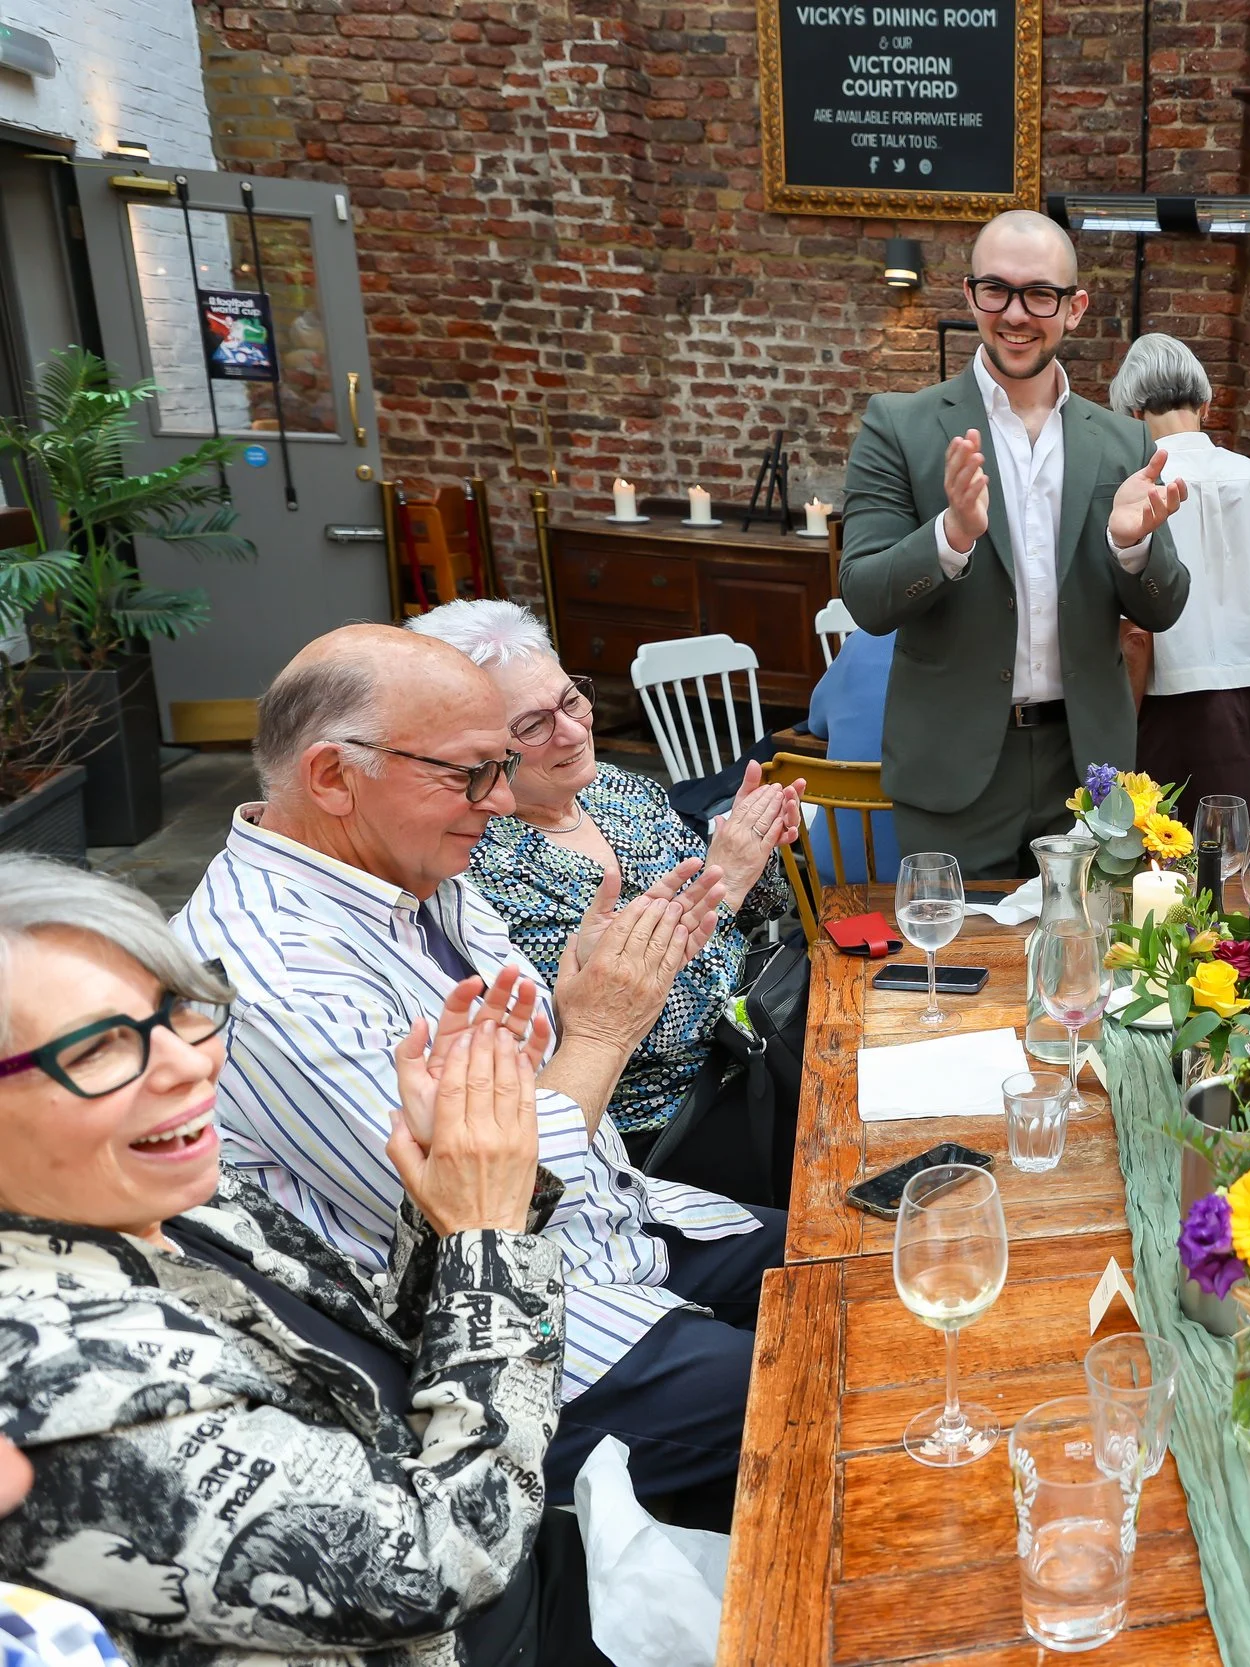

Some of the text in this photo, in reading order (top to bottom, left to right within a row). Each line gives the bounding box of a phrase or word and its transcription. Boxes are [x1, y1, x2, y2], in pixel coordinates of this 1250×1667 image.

[796, 5, 996, 28] VICKY'S DINING ROOM
[878, 36, 913, 50] & OUR
[848, 55, 952, 75] VICTORIAN
[841, 79, 958, 98] COURTYARD
[814, 108, 983, 127] ARE AVAILABLE FOR PRIVATE HIRE
[851, 133, 878, 147] COME
[880, 134, 907, 148] TALK
[909, 135, 922, 149] TO
[210, 306, 262, 317] world cup
